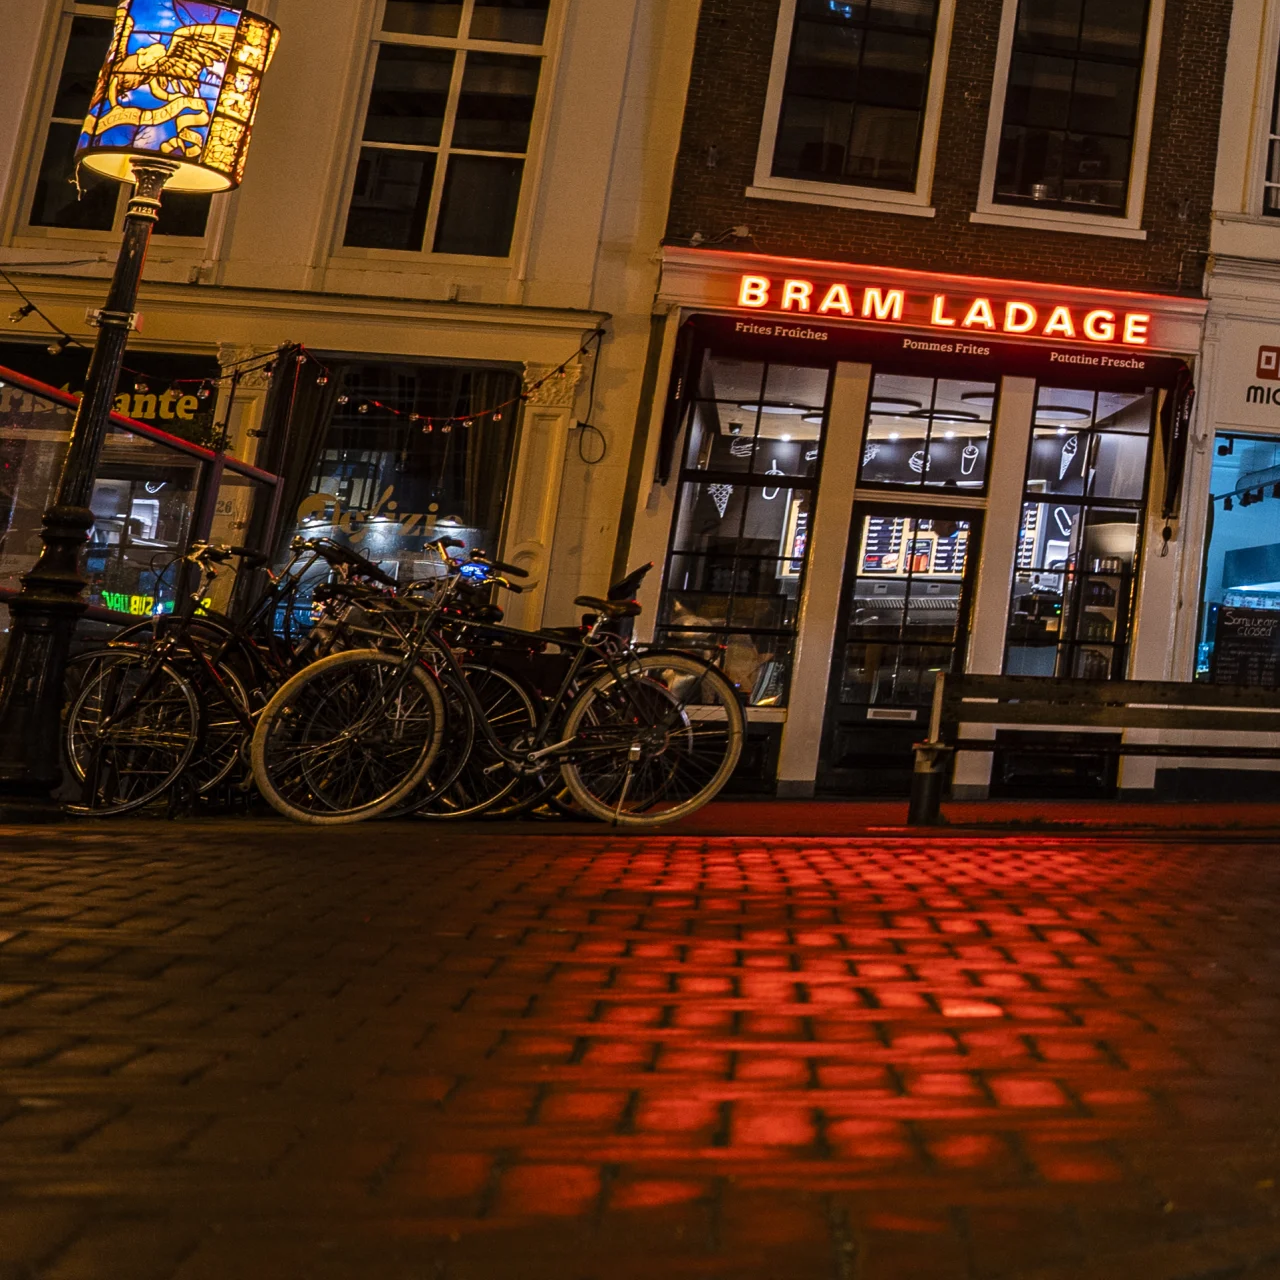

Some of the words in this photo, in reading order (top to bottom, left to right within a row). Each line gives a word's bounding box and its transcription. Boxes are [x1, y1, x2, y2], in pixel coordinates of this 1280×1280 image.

[737, 275, 905, 321] BRAM
[930, 293, 1151, 345] LADAGE
[735, 322, 772, 336] Frites
[774, 326, 828, 341] Fraîches
[902, 338, 953, 352] Pommes
[955, 343, 990, 356] Frites
[1050, 351, 1099, 366] Patatine
[1100, 355, 1146, 369] Fresche
